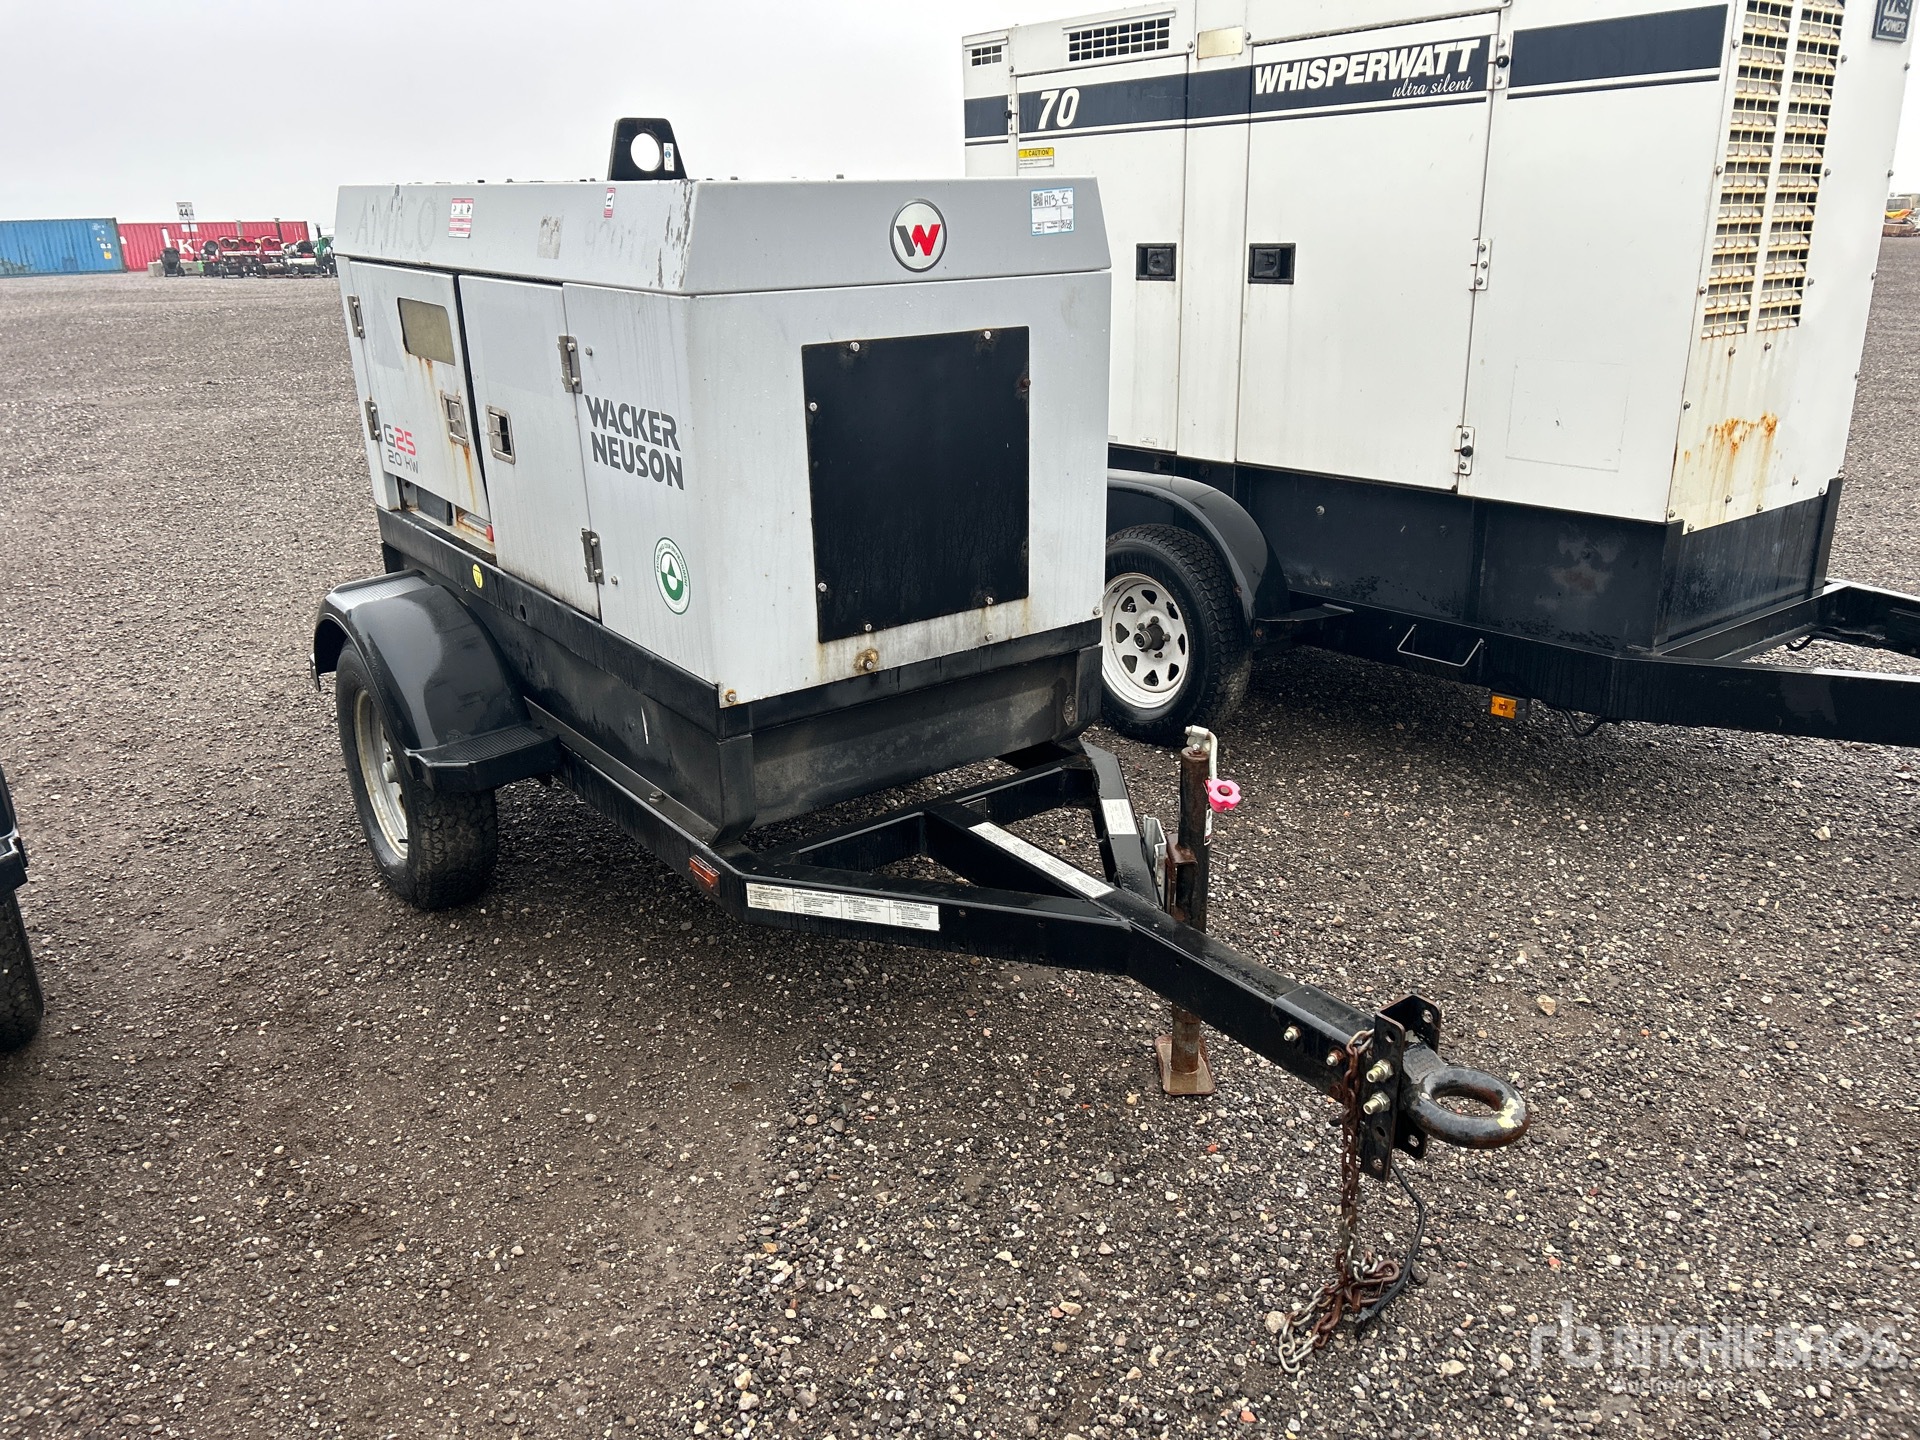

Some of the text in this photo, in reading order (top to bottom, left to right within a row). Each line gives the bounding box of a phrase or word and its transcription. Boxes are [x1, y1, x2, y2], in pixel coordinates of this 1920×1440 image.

[1881, 19, 1906, 33] POWER
[1255, 39, 1480, 94] WHISPERWATT
[1392, 74, 1473, 98] ultra silent
[1038, 87, 1080, 130] 70
[1028, 149, 1049, 157] CAUTION
[584, 394, 680, 451] WACKER
[384, 424, 416, 455] G25
[388, 449, 402, 466] 20
[590, 431, 684, 490] NEUSON
